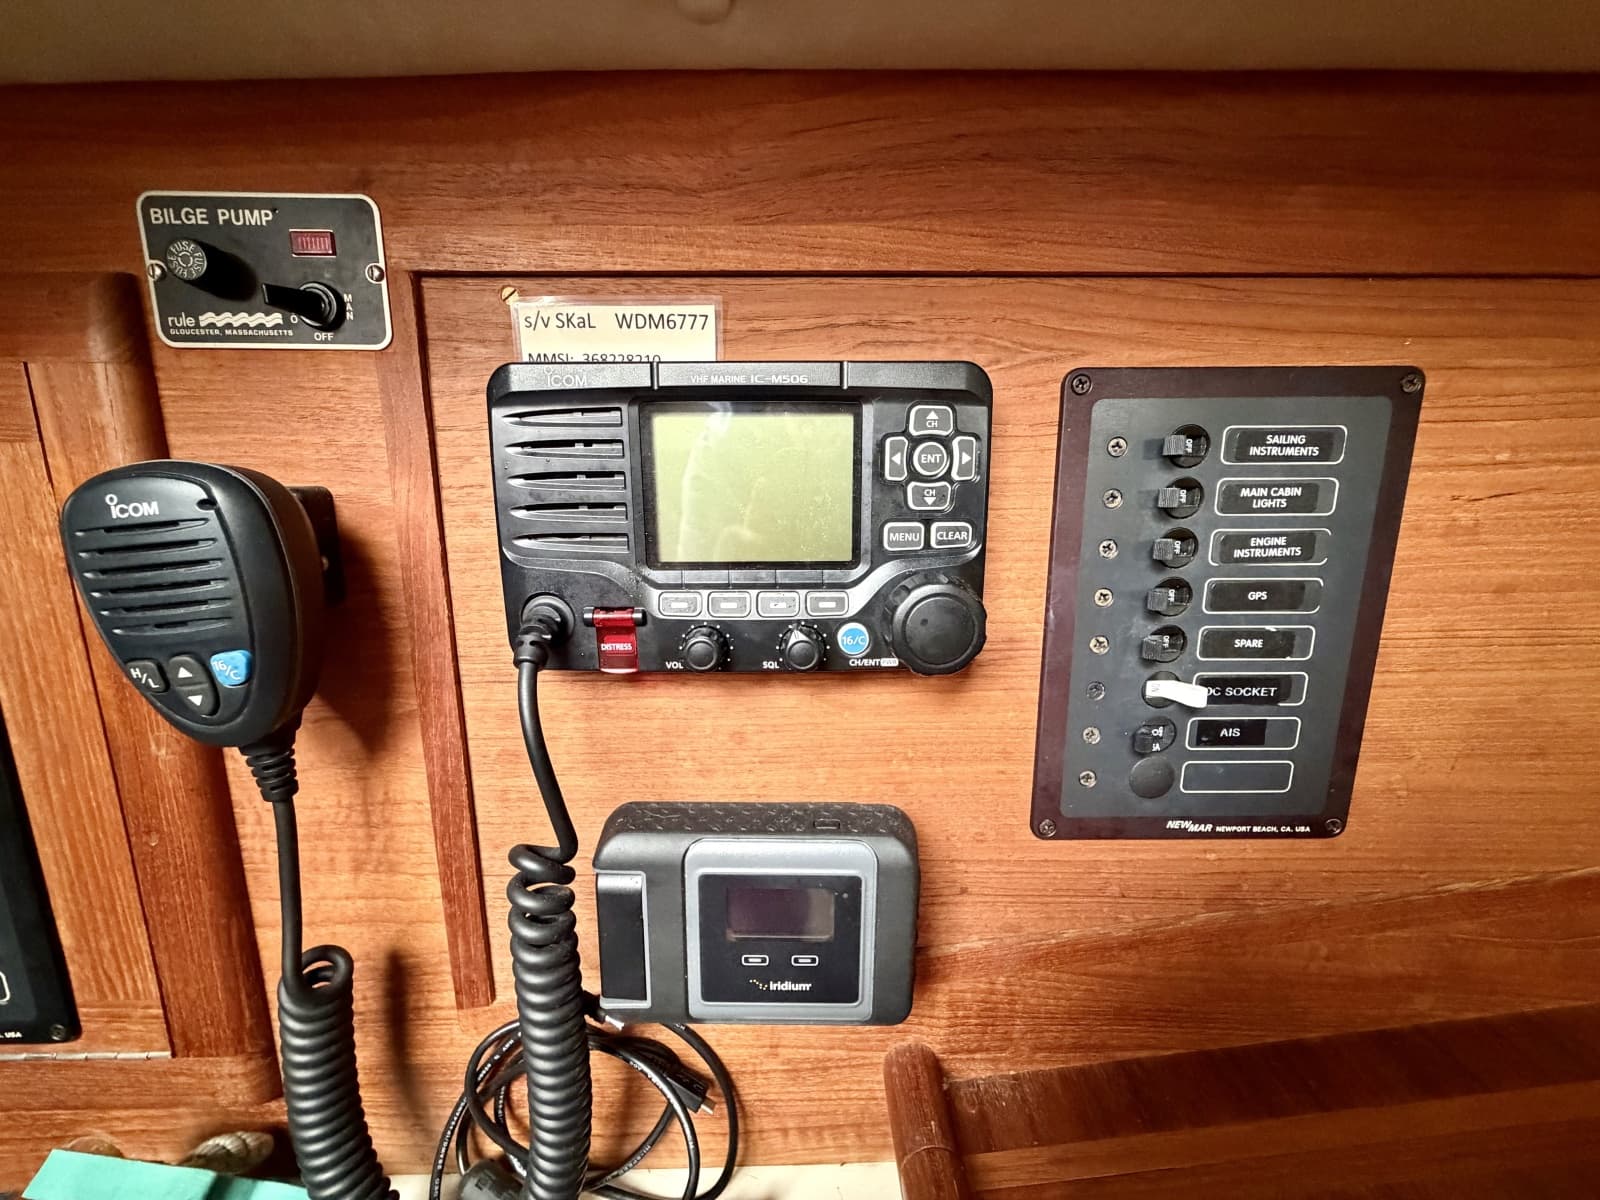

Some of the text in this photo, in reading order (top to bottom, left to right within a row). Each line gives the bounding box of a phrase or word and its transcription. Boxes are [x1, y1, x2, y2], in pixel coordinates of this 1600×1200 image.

[150, 207, 273, 226] BILGE PUMP
[170, 240, 195, 254] FUSE
[168, 311, 196, 327] rule
[524, 310, 709, 331] s/v SKaL WDM6777
[170, 328, 294, 337] GLOUCESTER, MASSACHUSETTS
[313, 332, 335, 341] OFF
[690, 374, 809, 384] VHF MARINE IC-M506
[926, 420, 938, 428] CH
[1265, 434, 1306, 445] SAILING
[1249, 446, 1319, 457] INSTRUMENTS
[920, 454, 942, 464] ENT
[1240, 486, 1302, 497] MAIN CABIN
[1252, 498, 1287, 509] LIGHTS
[889, 532, 920, 542] MENU
[936, 531, 968, 541] CLEAR
[1250, 536, 1287, 547] ENGINE
[1233, 547, 1302, 558] INSTRUMENTS
[1247, 591, 1268, 600] GPS
[842, 635, 866, 646] 16/C
[1234, 639, 1264, 648] SPARE
[600, 643, 633, 651] DISTRESS
[665, 661, 683, 669] VOL
[762, 661, 780, 670] SQL
[849, 658, 880, 667] CH/ENT
[211, 660, 241, 681] 16/C
[129, 667, 160, 689] H/L
[1224, 687, 1278, 697] SOCKET
[1219, 728, 1241, 737] AIS
[770, 980, 812, 991] iridium
